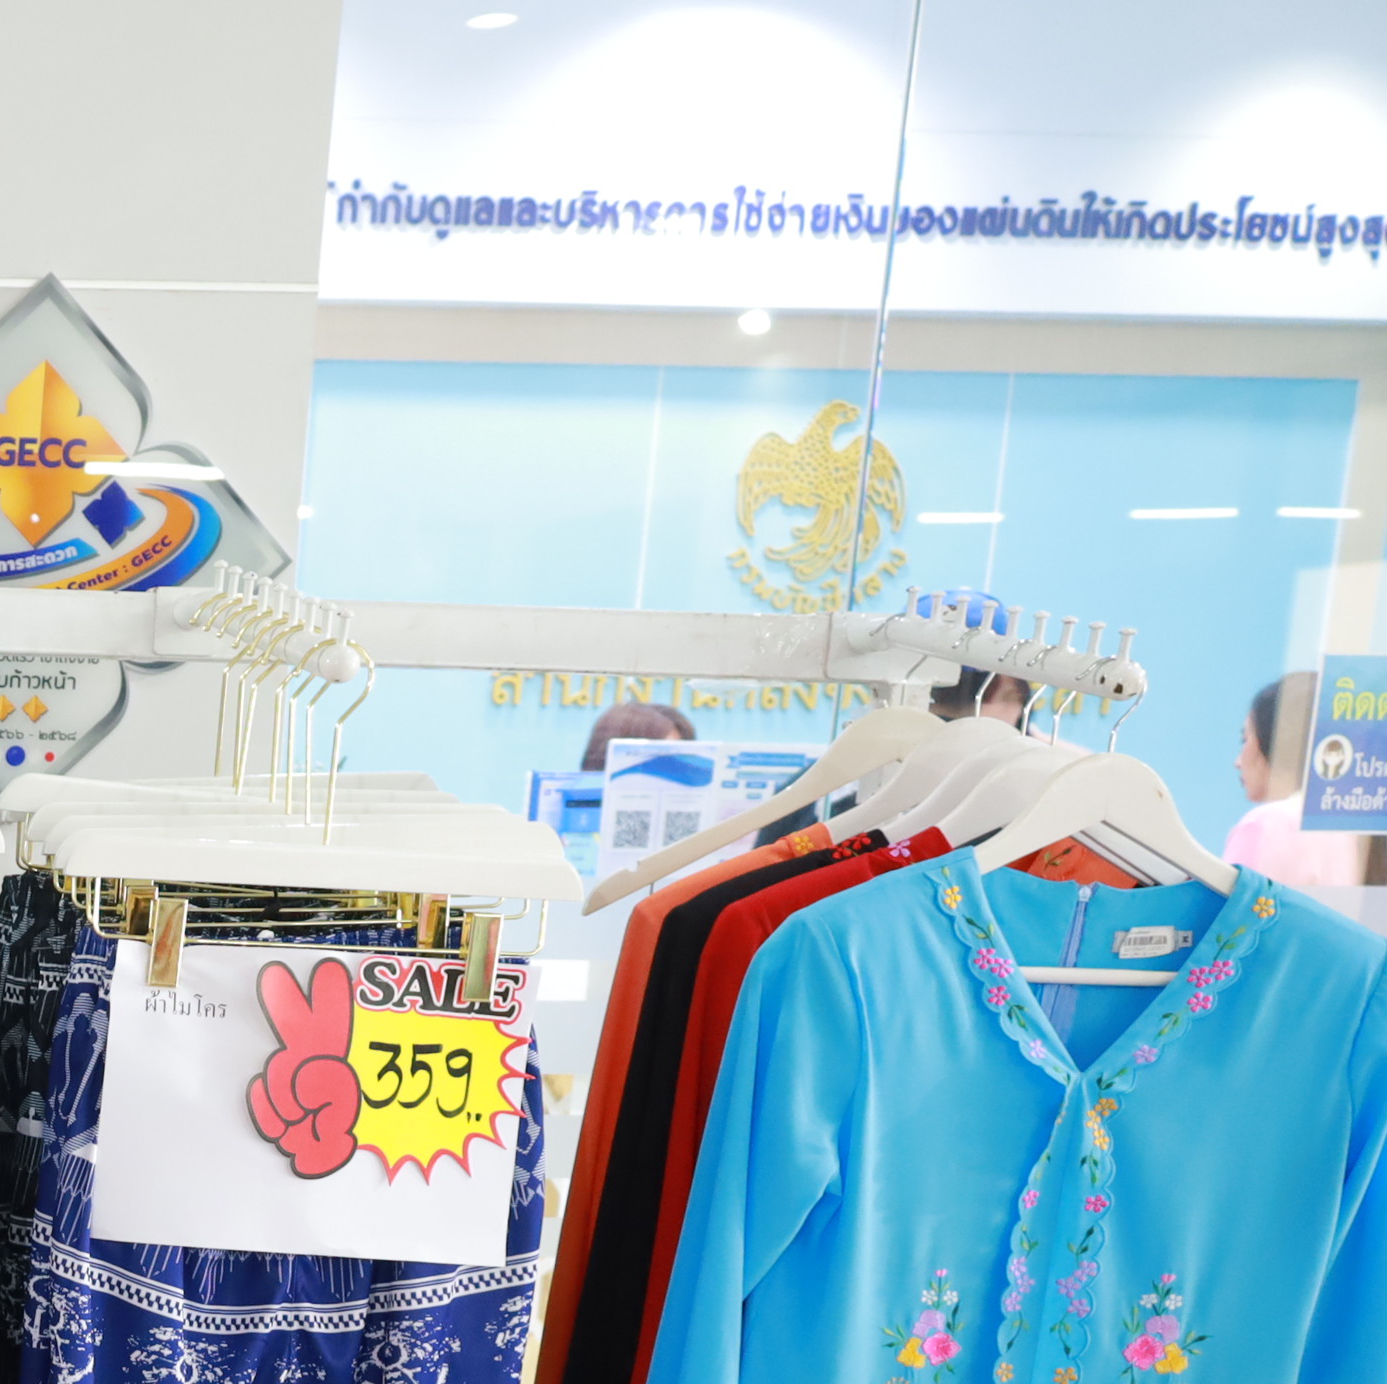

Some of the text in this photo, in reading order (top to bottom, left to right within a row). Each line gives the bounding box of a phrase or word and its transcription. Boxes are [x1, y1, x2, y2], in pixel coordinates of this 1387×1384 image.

[67, 568, 119, 590] Center
[130, 535, 173, 567] GECC
[1321, 787, 1387, 811] ล้างมือด้
[145, 989, 227, 1018] ผ้าไมโคร
[363, 961, 520, 1018] SALE
